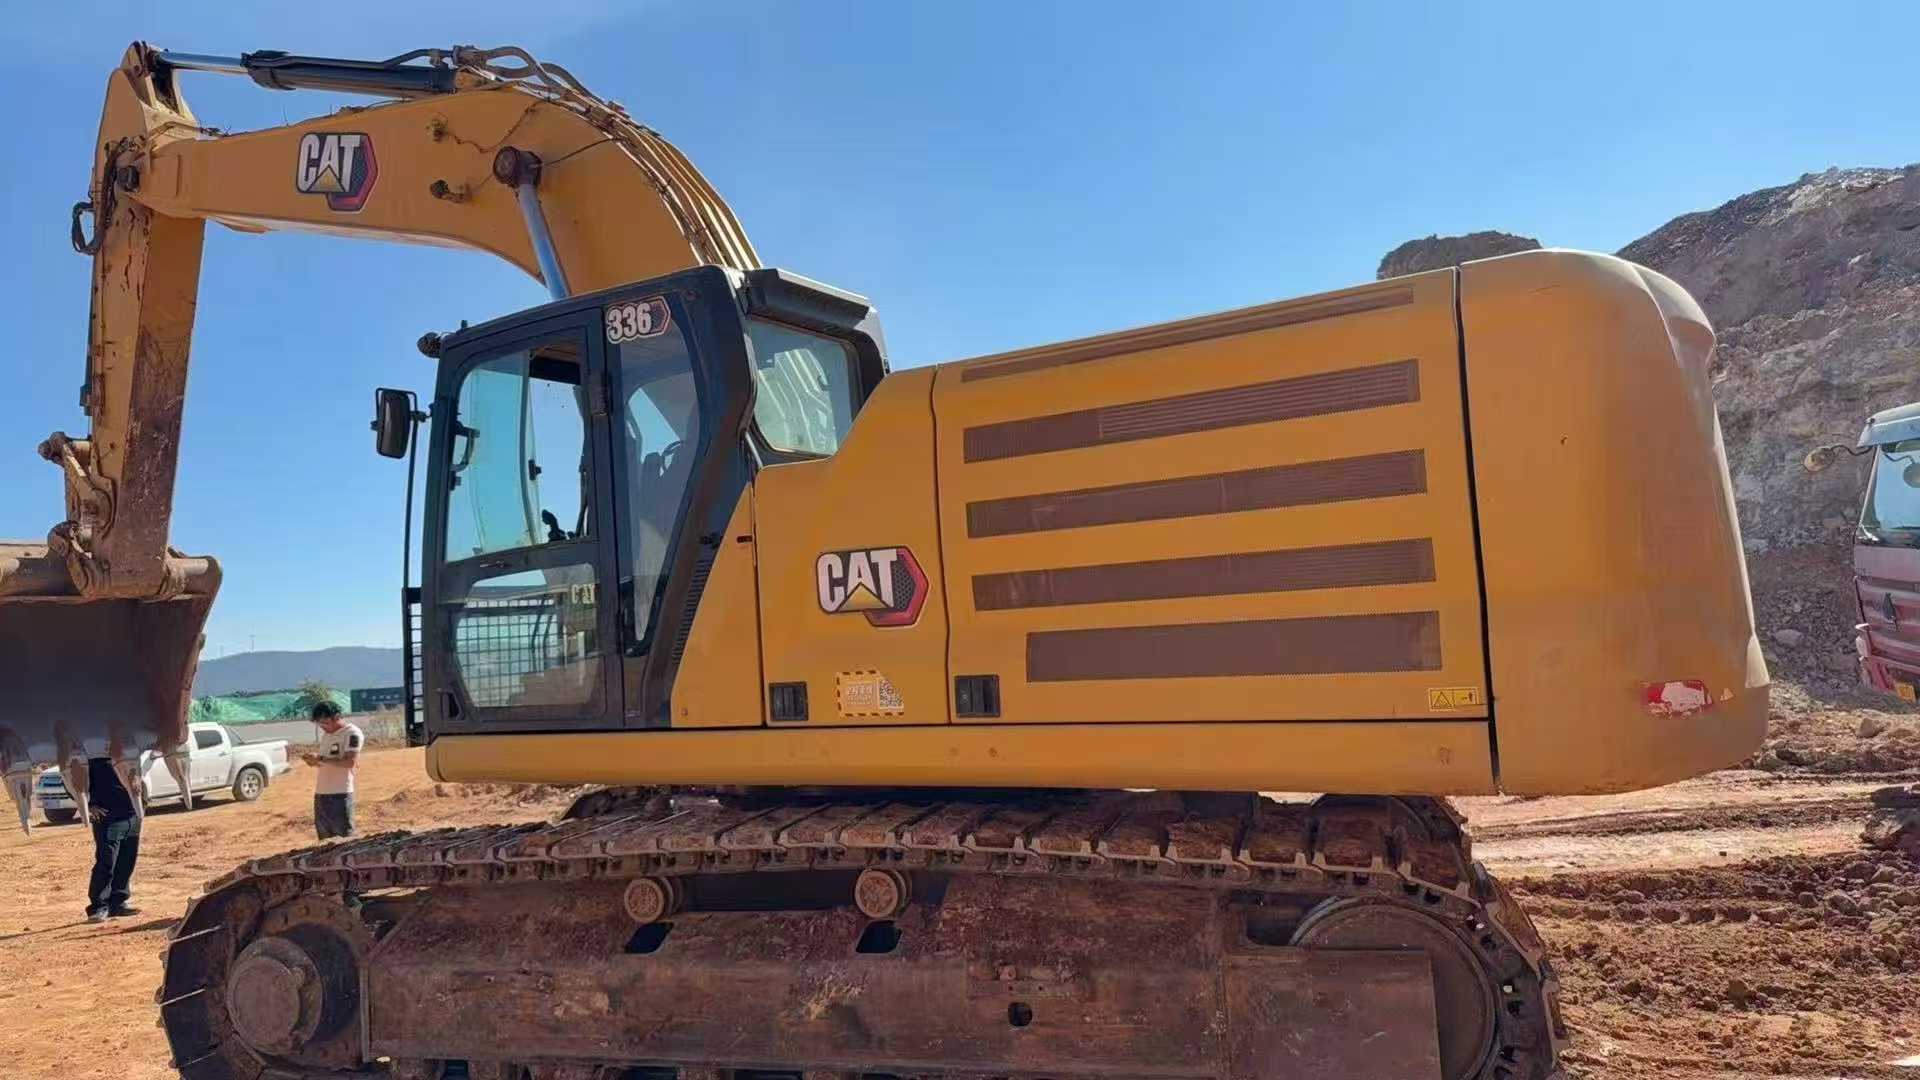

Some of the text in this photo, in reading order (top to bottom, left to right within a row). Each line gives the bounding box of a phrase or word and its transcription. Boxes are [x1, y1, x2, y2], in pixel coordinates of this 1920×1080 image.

[297, 134, 361, 192] CAT
[608, 303, 651, 340] 336
[817, 549, 897, 612] CAT
